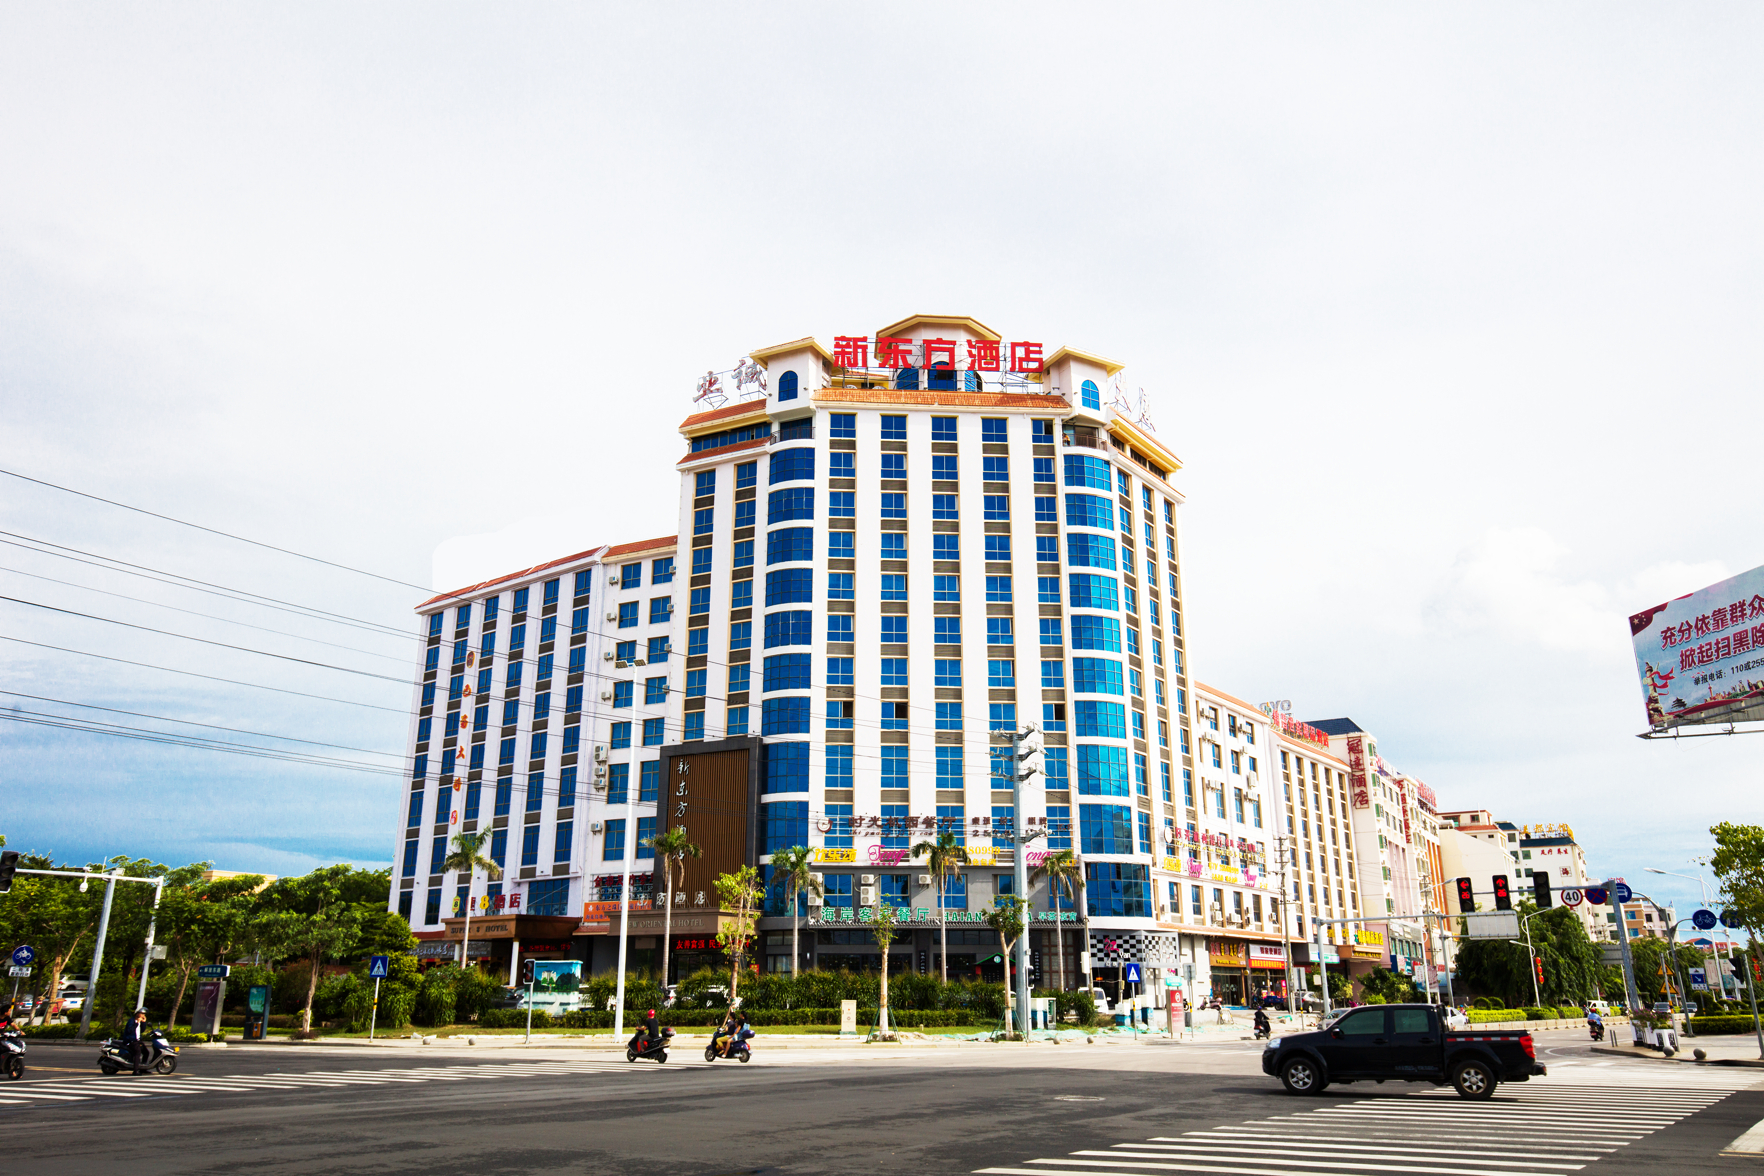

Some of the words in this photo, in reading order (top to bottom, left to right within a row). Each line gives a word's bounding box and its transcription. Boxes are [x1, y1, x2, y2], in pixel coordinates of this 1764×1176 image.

[833, 335, 1043, 373] 新东方酒店
[1661, 594, 1764, 649] 充分依靠群众
[1680, 623, 1764, 672] 掀起扫黑除
[848, 816, 957, 828] 时光机西餐厅
[813, 848, 857, 862] 欢乐颂
[1565, 891, 1579, 902] 40
[820, 907, 930, 921] 海岸客家餐厅
[485, 924, 508, 932] HOTEL
[640, 919, 676, 928] ORIENAL
[679, 918, 704, 927] HOTEL
[676, 940, 705, 949] 友善富强
